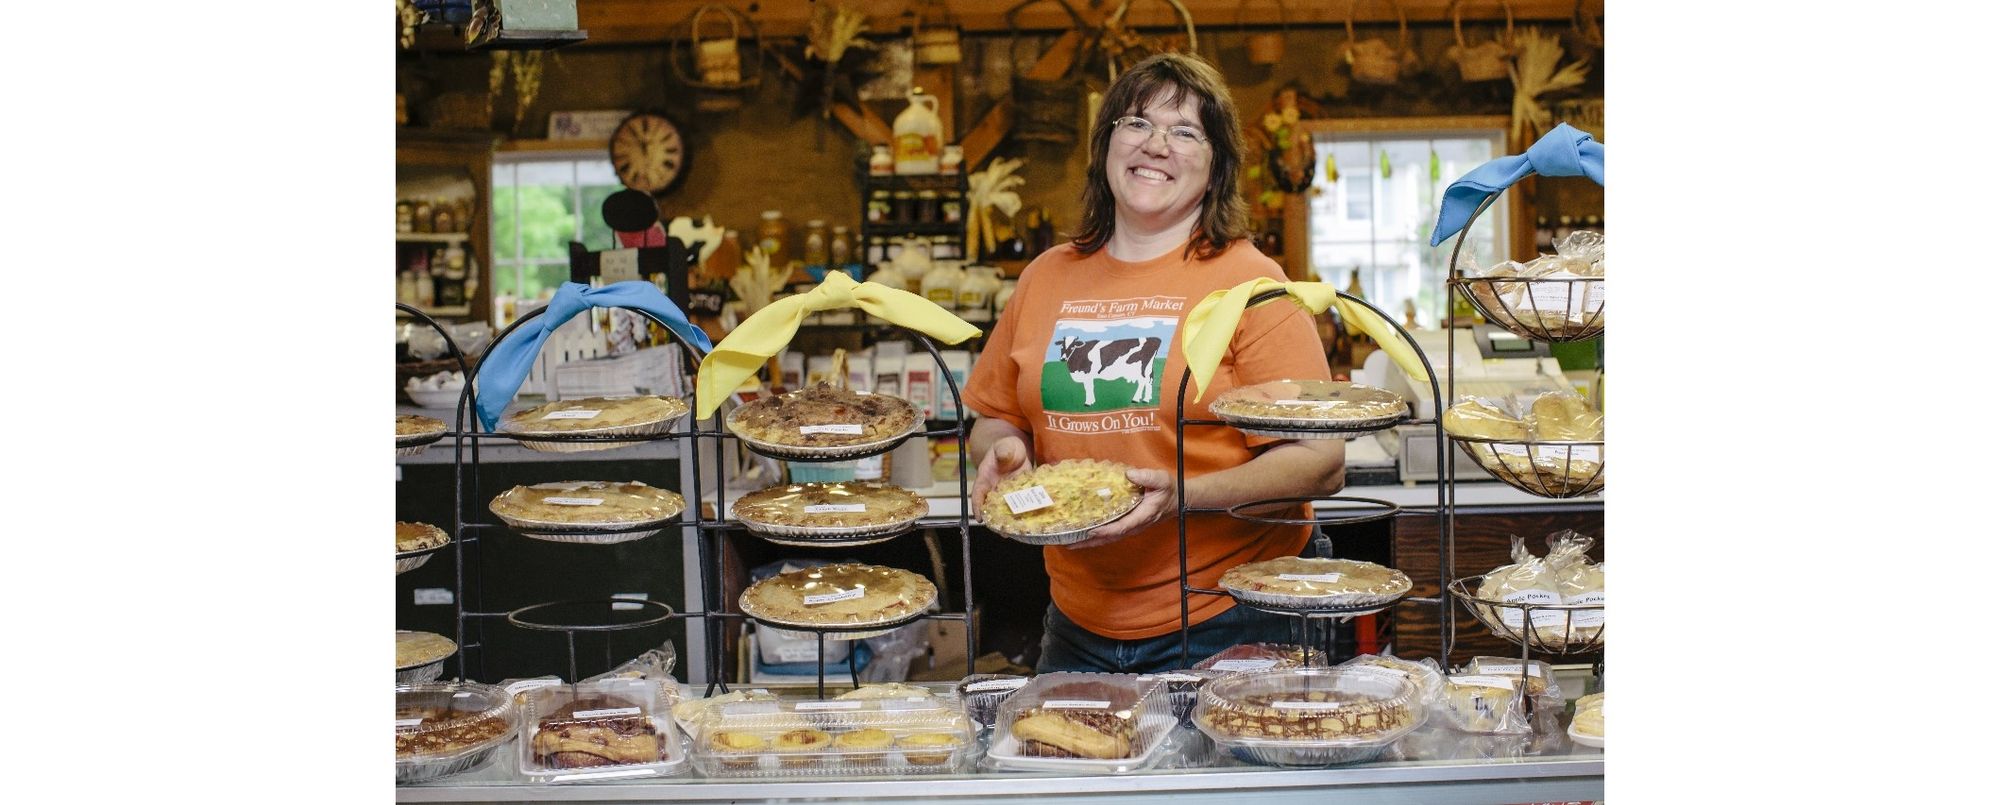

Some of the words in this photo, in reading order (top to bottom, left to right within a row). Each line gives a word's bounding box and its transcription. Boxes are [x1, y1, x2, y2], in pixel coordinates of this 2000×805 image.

[1061, 302, 1105, 313] Freund's
[1108, 302, 1138, 313] Farm
[1141, 299, 1184, 311] Market
[1048, 415, 1056, 428] It
[1059, 416, 1099, 431] Grows
[1101, 416, 1120, 430] On
[1122, 412, 1154, 428] You!
